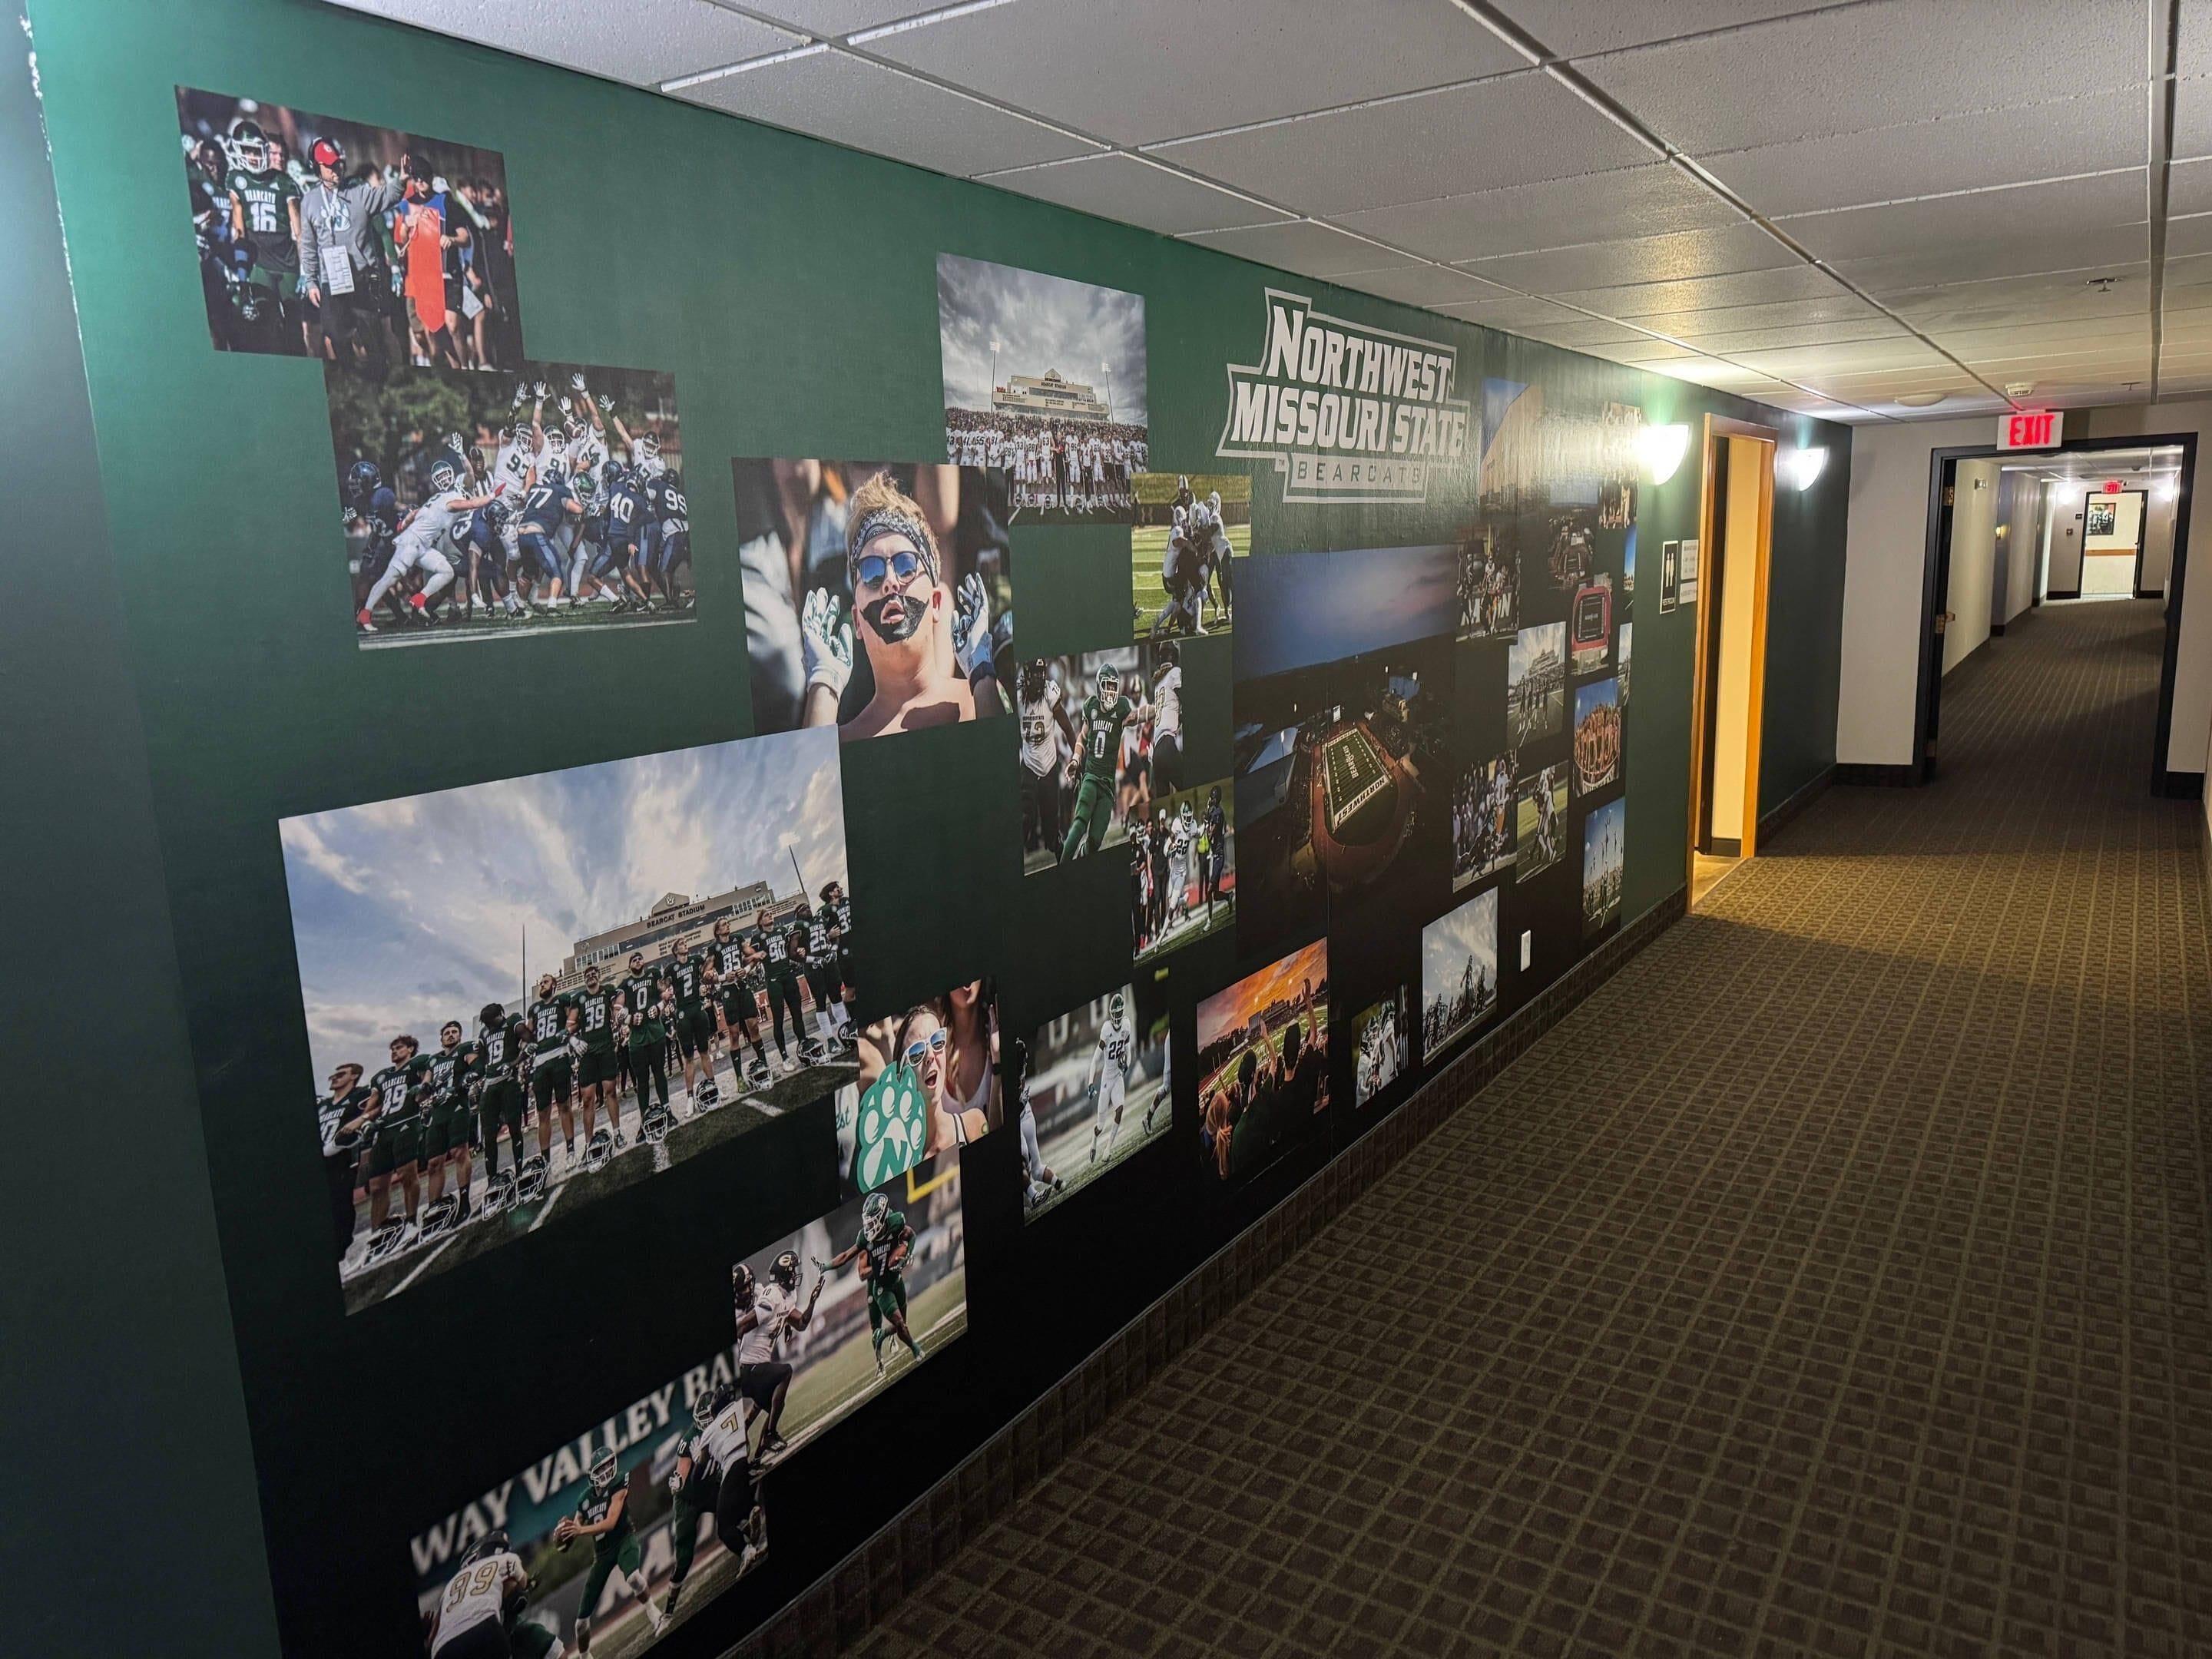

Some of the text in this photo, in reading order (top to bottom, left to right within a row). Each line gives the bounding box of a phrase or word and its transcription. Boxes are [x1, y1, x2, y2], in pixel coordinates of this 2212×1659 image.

[250, 202, 277, 233] 16
[1265, 305, 1452, 404] NORTHWEST
[1230, 381, 1466, 455] MISSOURI STATE
[2008, 414, 2056, 447] EXIT
[1297, 461, 1421, 484] BEARCATS
[609, 492, 634, 524] 40
[664, 488, 688, 516] 99
[1094, 730, 1106, 759] 0
[1336, 777, 1386, 826] NORTHWEST
[1177, 838, 1190, 855] 22
[647, 914, 675, 929] BEARCAT
[678, 904, 706, 918] STADIUM
[769, 940, 787, 963] 90
[810, 928, 827, 953] 25
[722, 950, 742, 975] 85
[636, 987, 647, 1011] 0
[682, 973, 693, 998] 2
[537, 1013, 558, 1043] 86
[584, 1003, 606, 1033] 39
[487, 1039, 505, 1067] 19
[1108, 1040, 1124, 1060] 22
[877, 1252, 888, 1277] 7
[720, 1412, 739, 1433] 7
[410, 1479, 514, 1576] WAY
[522, 1381, 675, 1505] VALLEY
[445, 1561, 499, 1614] 99
